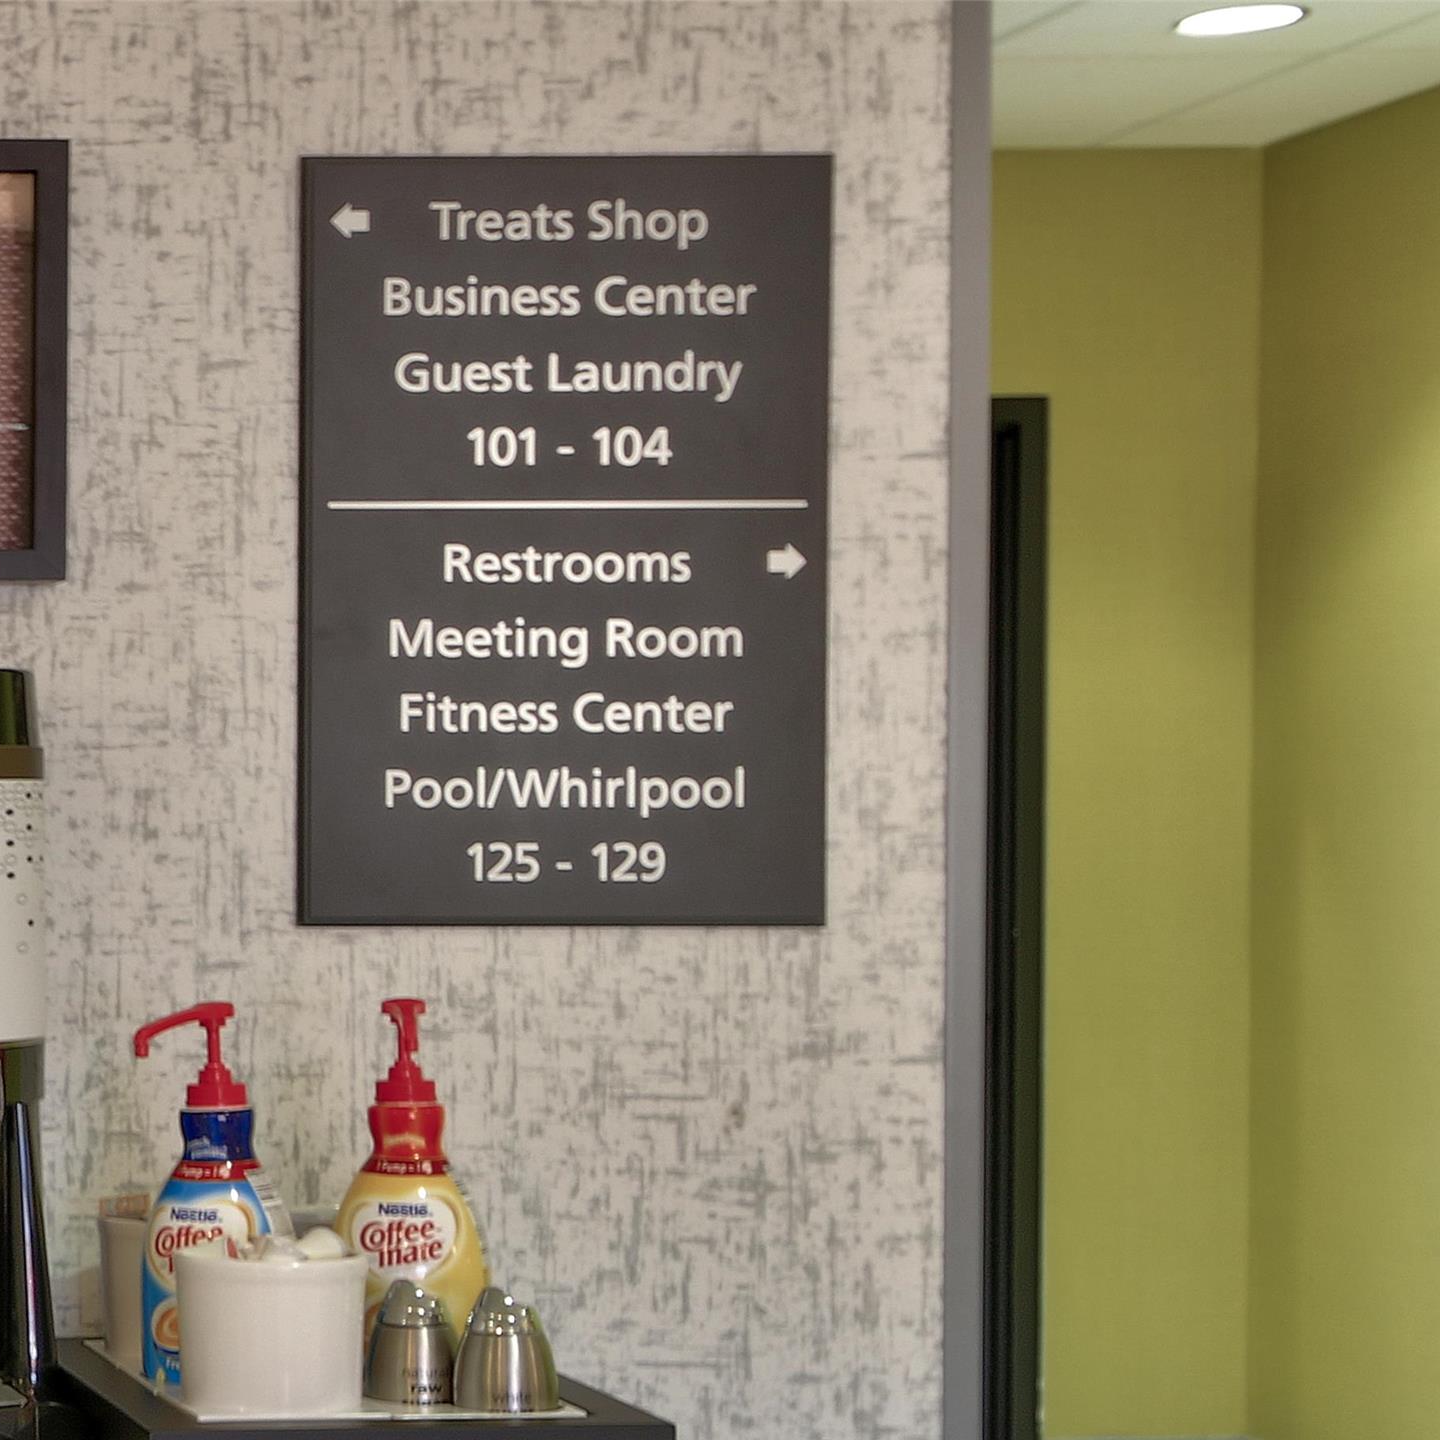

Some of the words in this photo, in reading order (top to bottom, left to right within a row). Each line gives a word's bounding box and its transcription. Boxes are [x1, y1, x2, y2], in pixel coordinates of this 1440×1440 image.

[428, 201, 574, 241] Treats
[587, 198, 709, 250] Shop
[383, 275, 581, 317] Business
[594, 275, 758, 317] Center
[394, 352, 534, 393] Guest
[547, 349, 743, 403] Laundry
[466, 426, 536, 467] 101
[555, 445, 576, 455] -
[591, 425, 674, 467] 104
[443, 543, 692, 584] Restrooms
[389, 616, 589, 669] Meeting
[605, 617, 744, 659] Room
[399, 691, 559, 733] Fitness
[572, 692, 734, 733] Center
[384, 765, 745, 819] Pool/Whirlpool
[466, 841, 540, 883] 125
[555, 861, 573, 871] -
[591, 841, 666, 883] 129
[410, 1385, 443, 1396] raw
